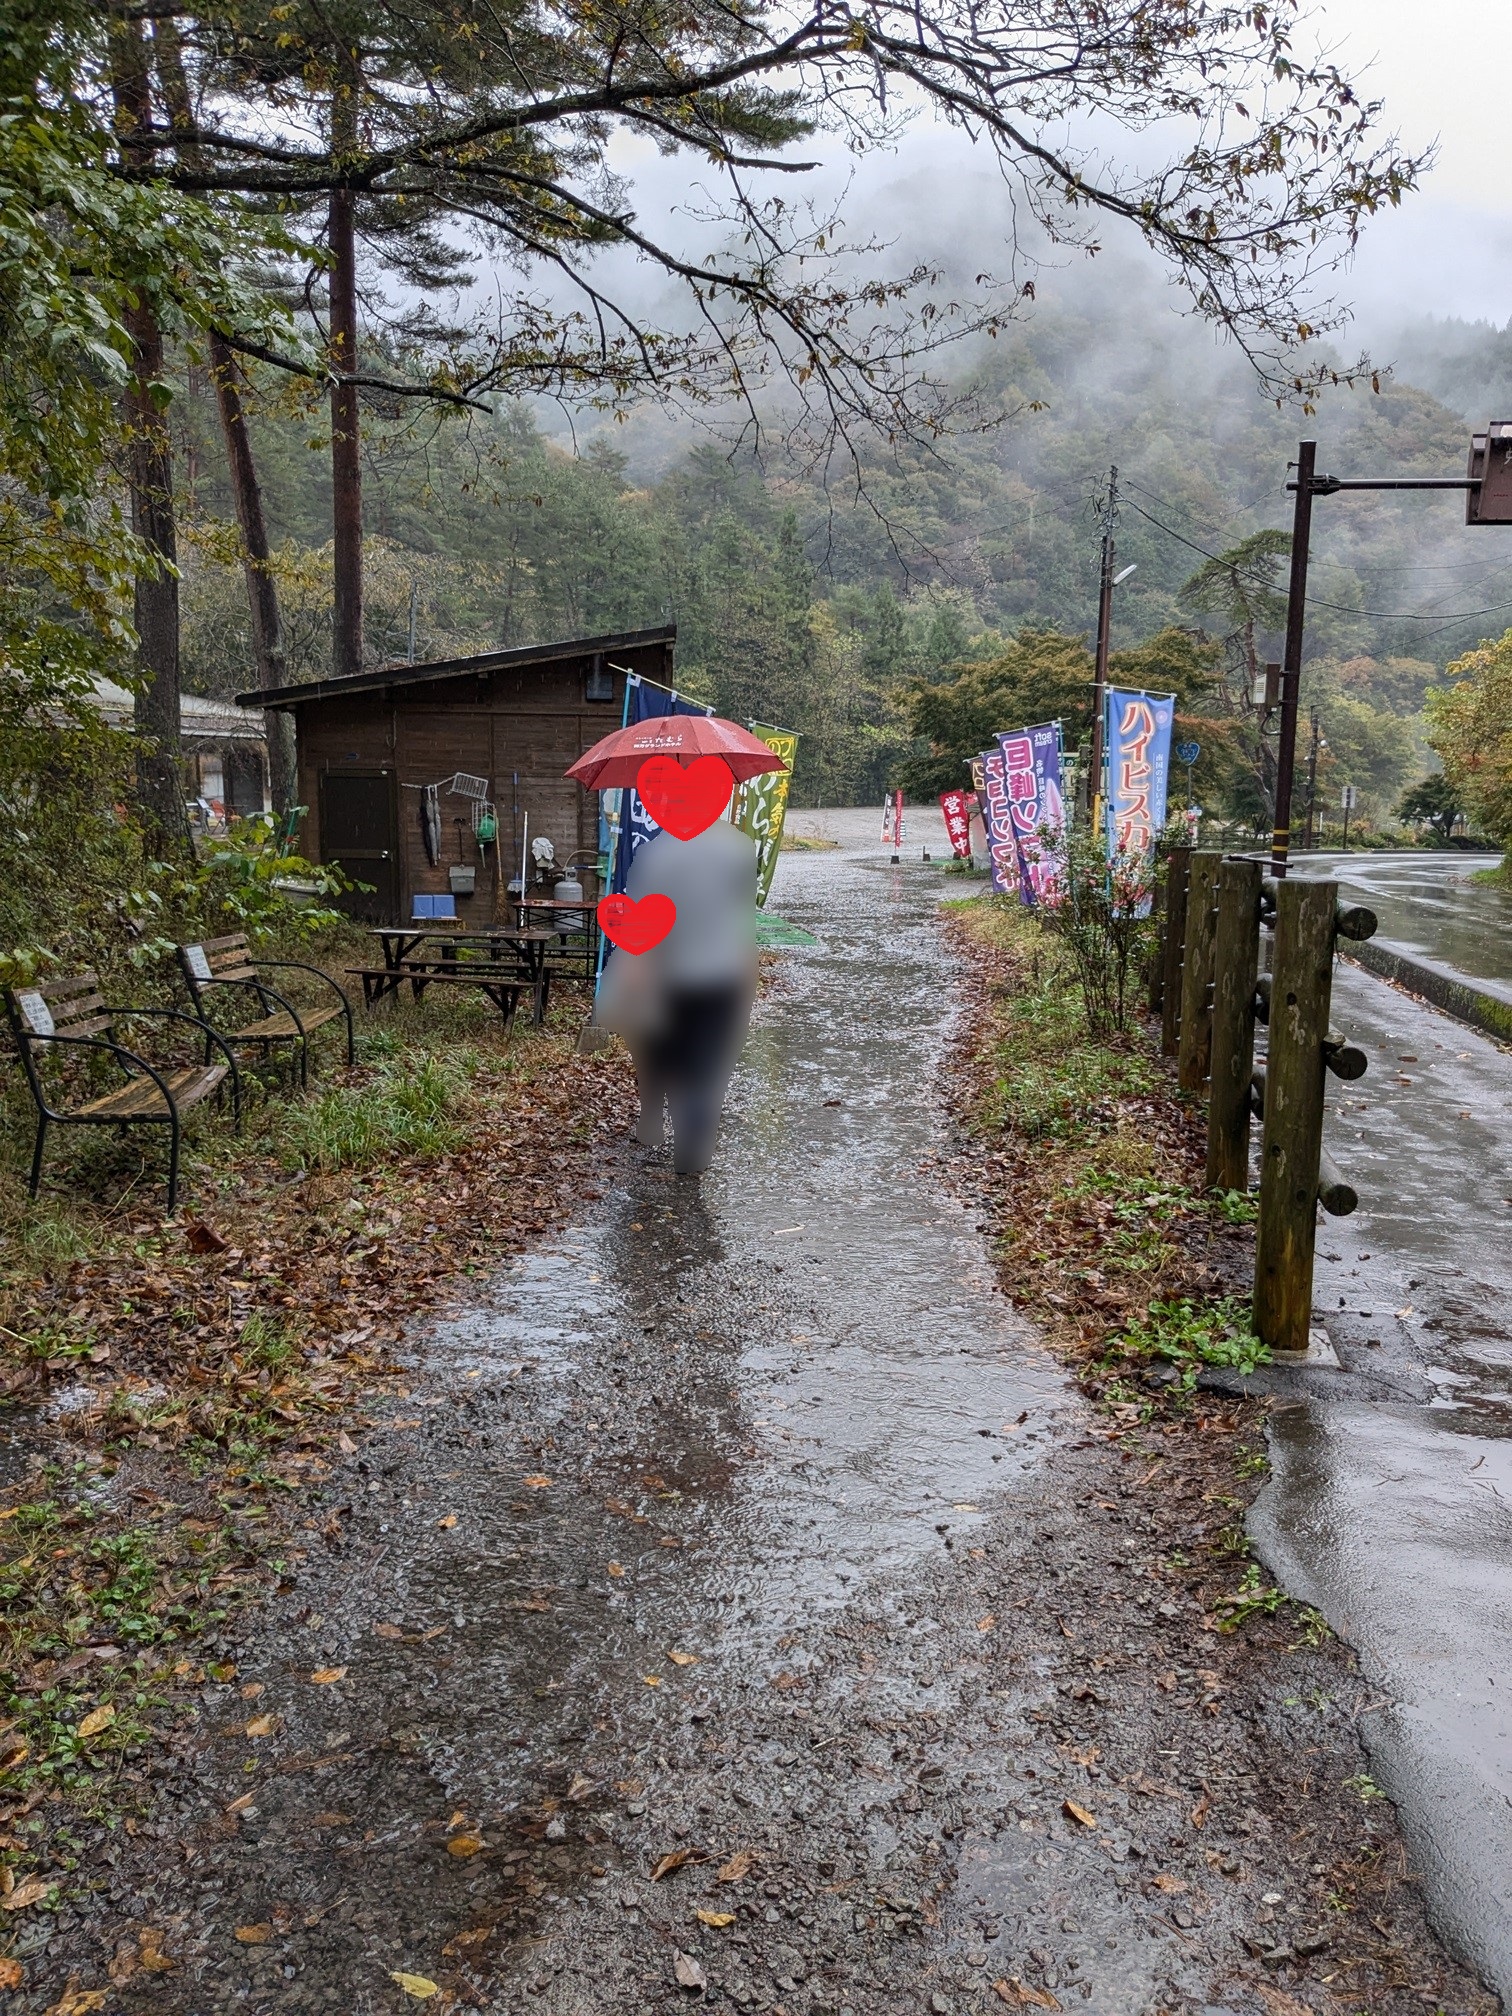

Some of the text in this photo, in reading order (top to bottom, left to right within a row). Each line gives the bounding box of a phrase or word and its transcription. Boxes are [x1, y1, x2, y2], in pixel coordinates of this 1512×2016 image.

[944, 795, 968, 855] 営業中
[1116, 702, 1155, 849] ハイビスカ
